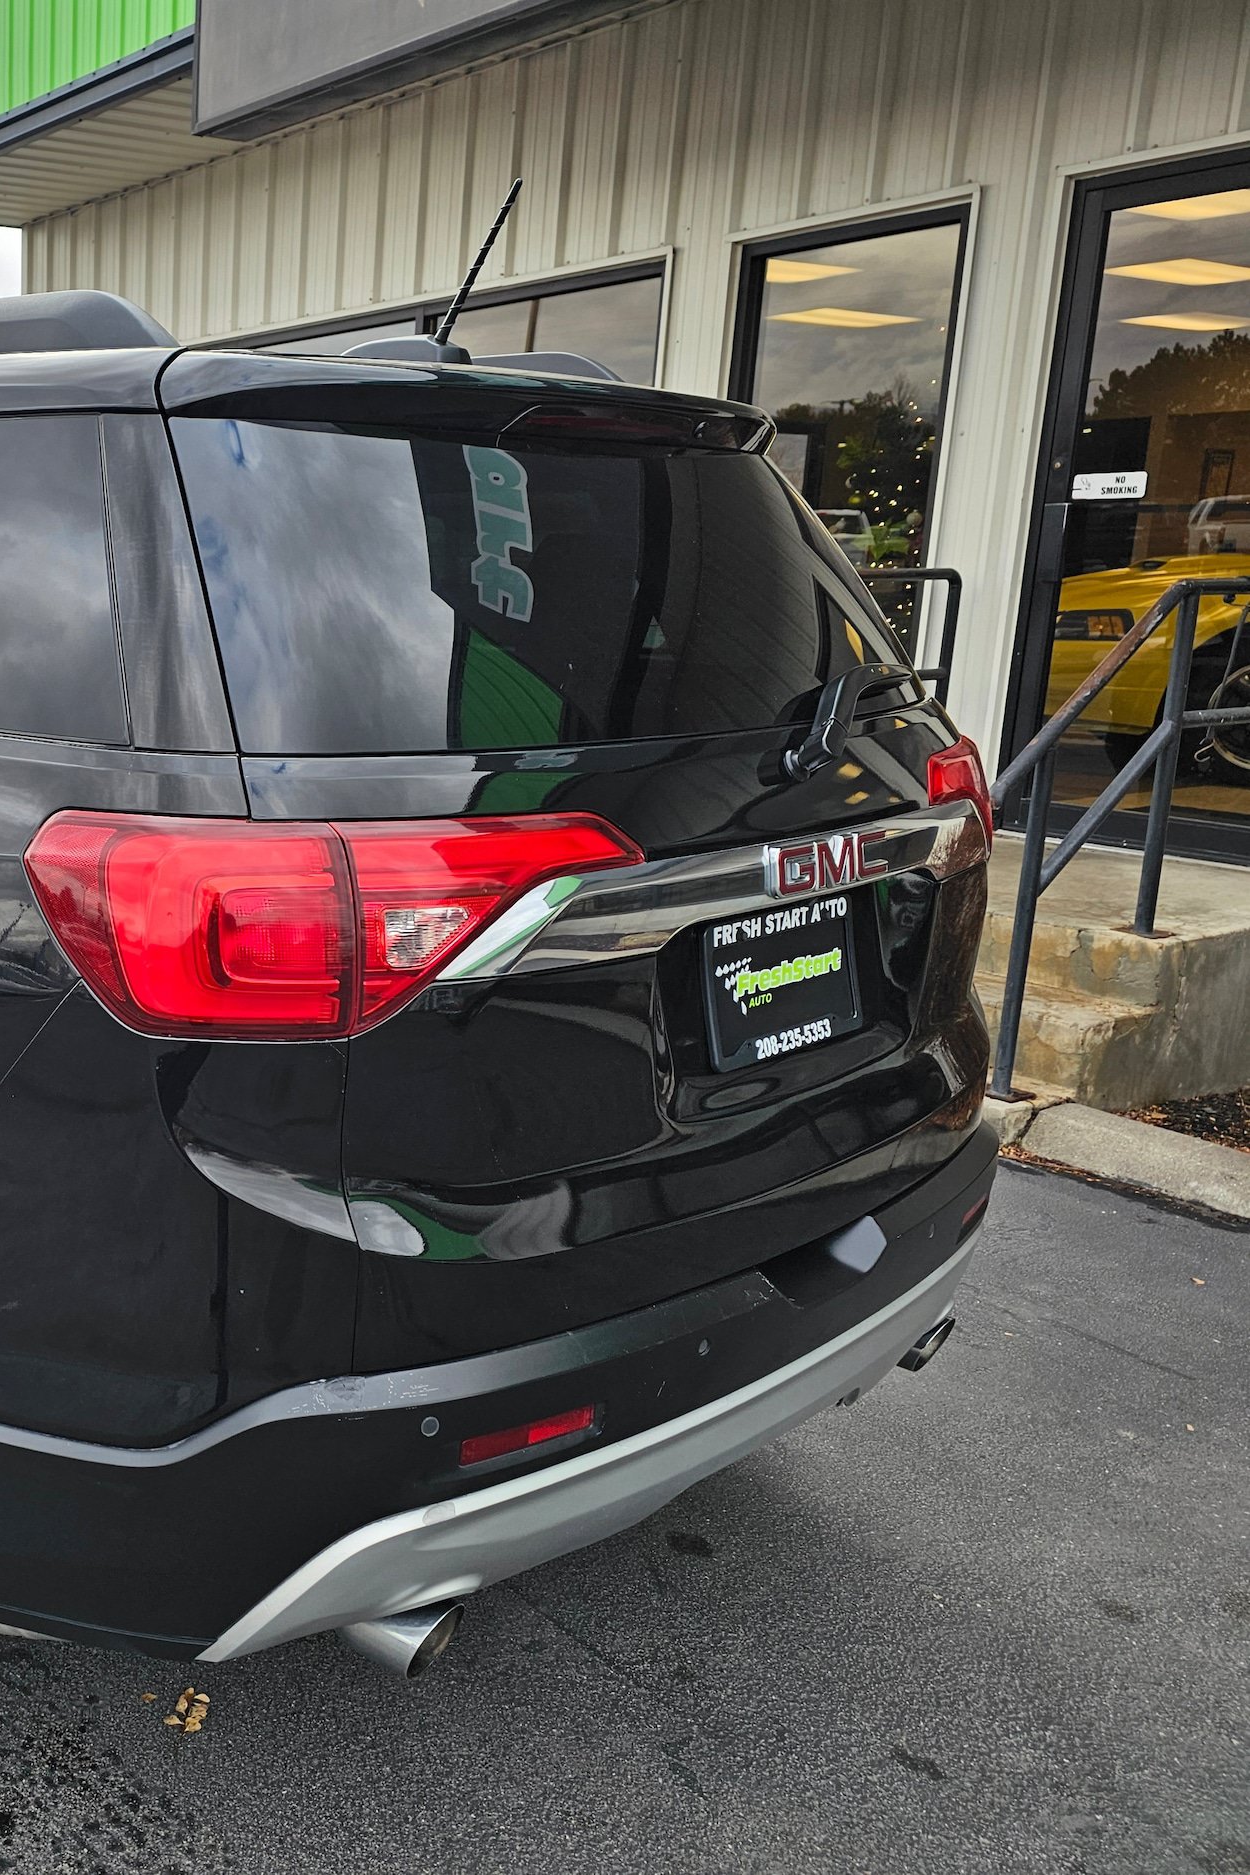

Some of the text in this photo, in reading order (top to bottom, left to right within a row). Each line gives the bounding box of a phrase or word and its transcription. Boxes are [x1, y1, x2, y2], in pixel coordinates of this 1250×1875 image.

[1100, 486, 1138, 495] SMOKING
[1114, 475, 1126, 484] NO
[772, 830, 888, 896] GMC
[765, 906, 809, 935] START
[736, 947, 842, 998] FreshStart
[748, 992, 772, 1009] AUTO
[755, 1018, 831, 1060] 208-235-5353
